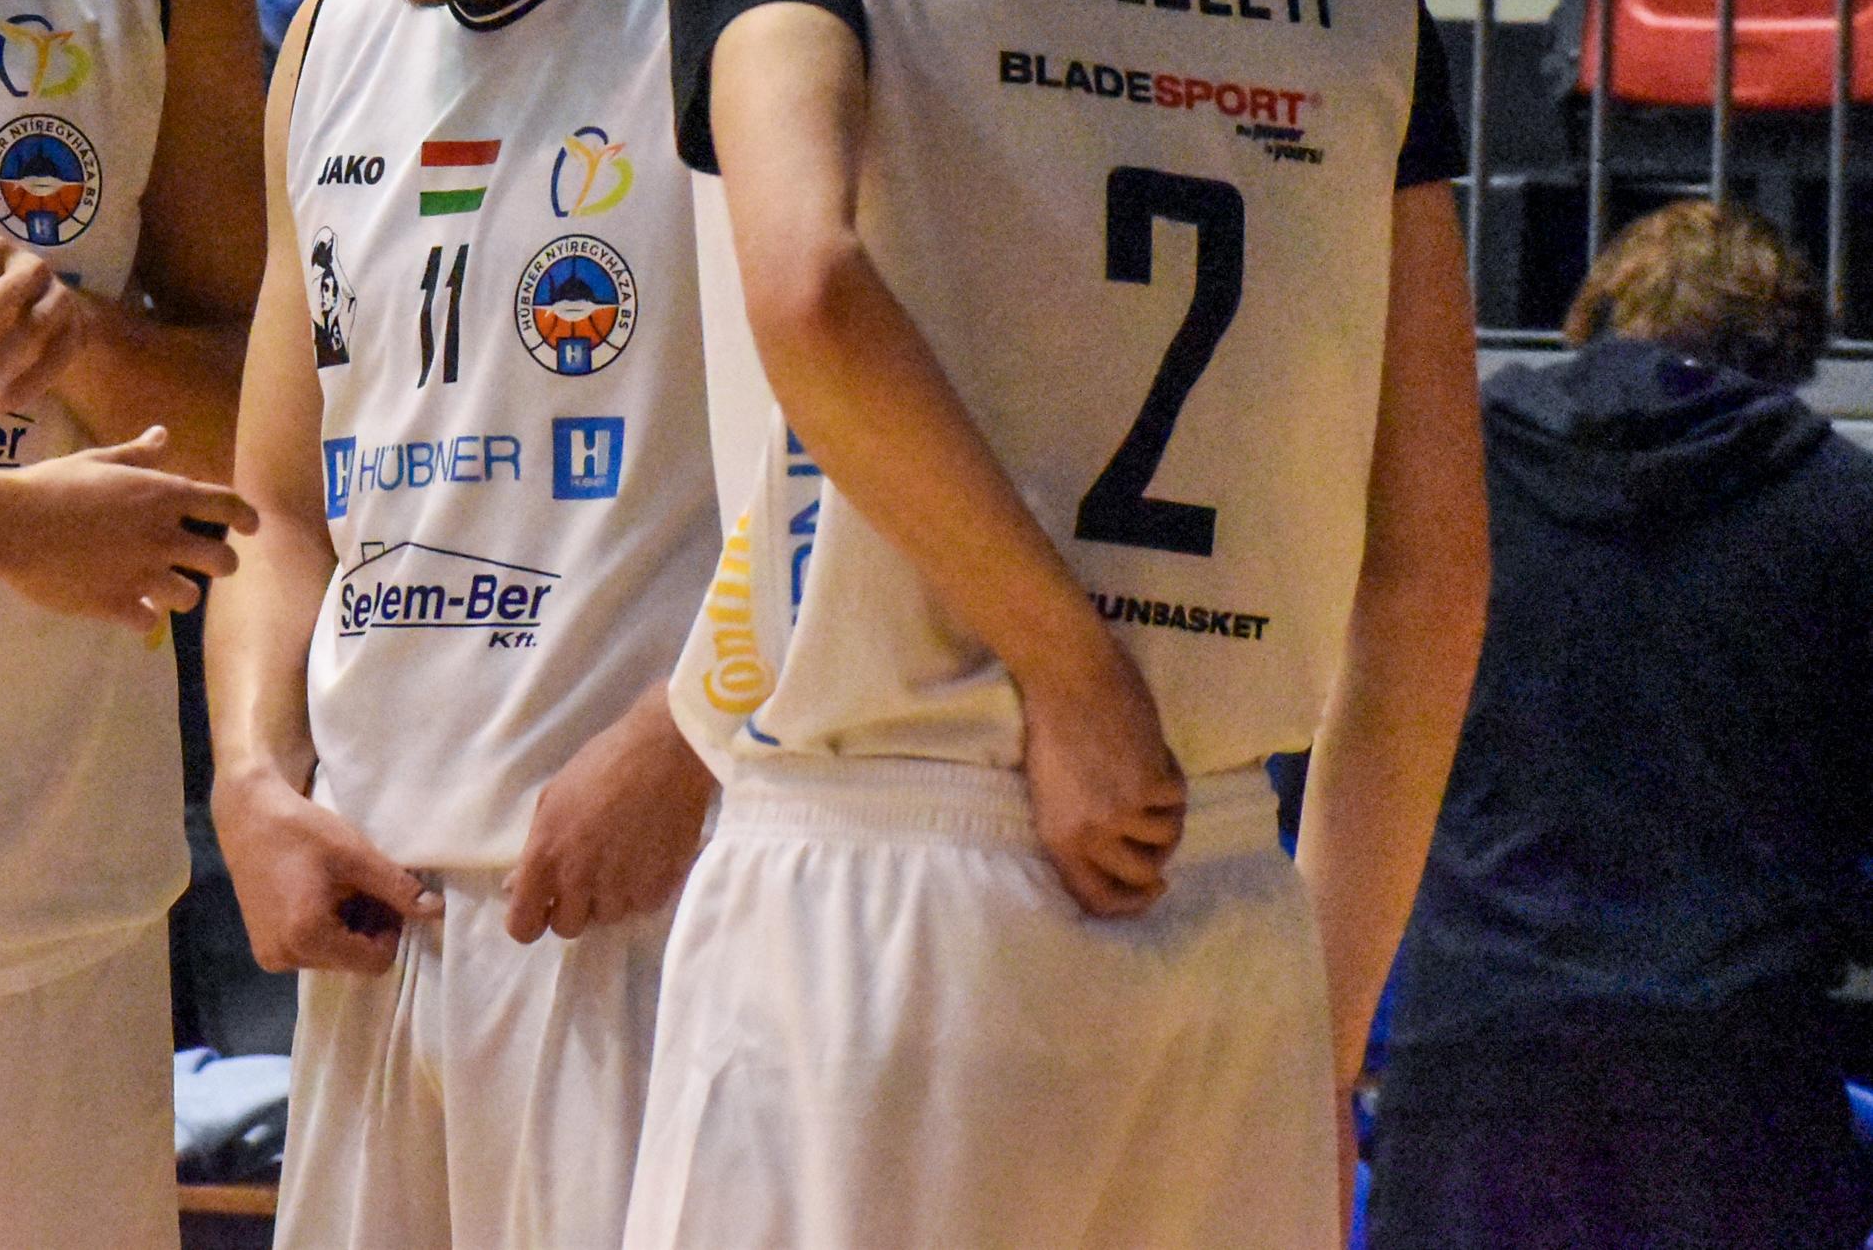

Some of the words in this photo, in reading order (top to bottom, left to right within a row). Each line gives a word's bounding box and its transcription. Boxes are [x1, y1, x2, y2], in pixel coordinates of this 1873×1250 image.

[1000, 50, 1307, 125] BLADESPORT
[318, 155, 385, 185] JAKO
[417, 244, 470, 389] 11
[1075, 166, 1245, 557] 2
[359, 435, 522, 492] HÜBNER
[1087, 592, 1270, 640] UNBASKET
